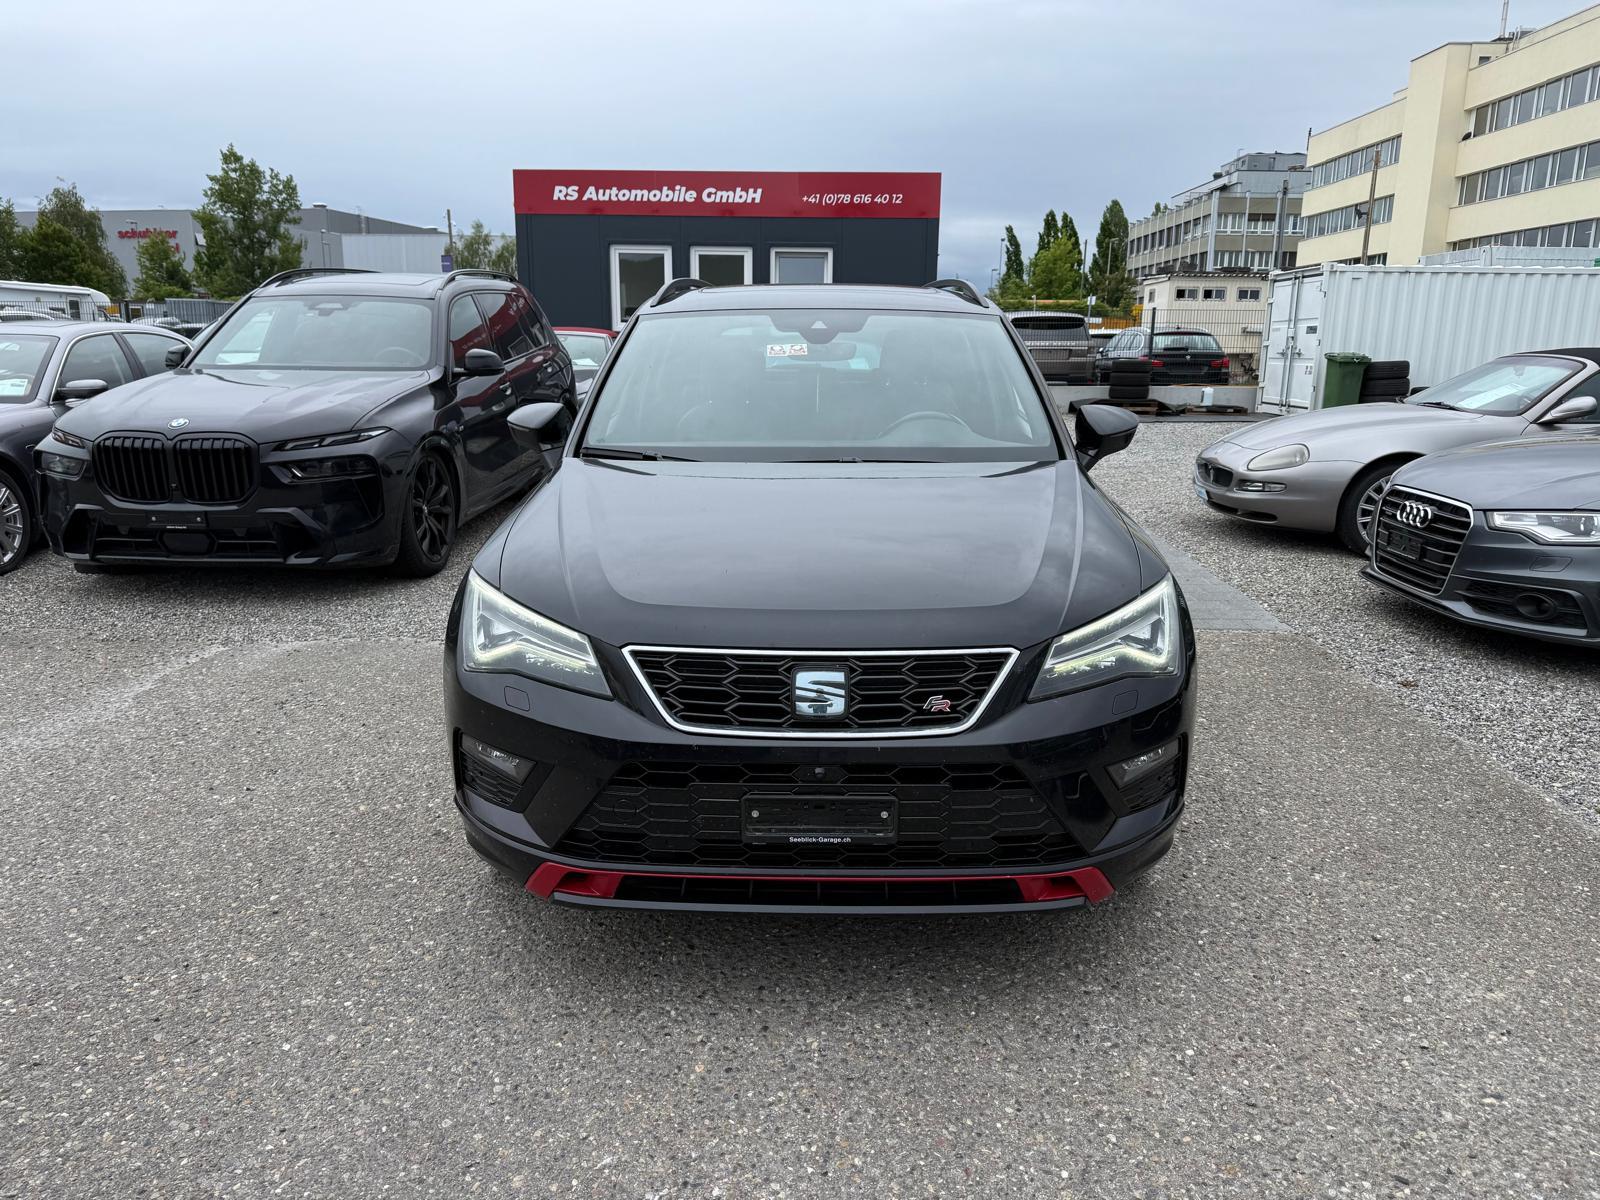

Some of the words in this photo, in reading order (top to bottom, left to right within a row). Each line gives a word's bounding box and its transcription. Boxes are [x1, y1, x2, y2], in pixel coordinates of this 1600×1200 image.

[553, 185, 580, 201] RS
[582, 185, 698, 203] Automobile
[702, 187, 763, 203] GmbH
[802, 194, 820, 204] +41
[823, 194, 851, 206] (0)78
[853, 194, 872, 204] 616
[874, 194, 890, 204] 40
[892, 194, 903, 204] 12
[923, 695, 951, 712] FR
[789, 836, 851, 844] Seeblick-Garage.ch
